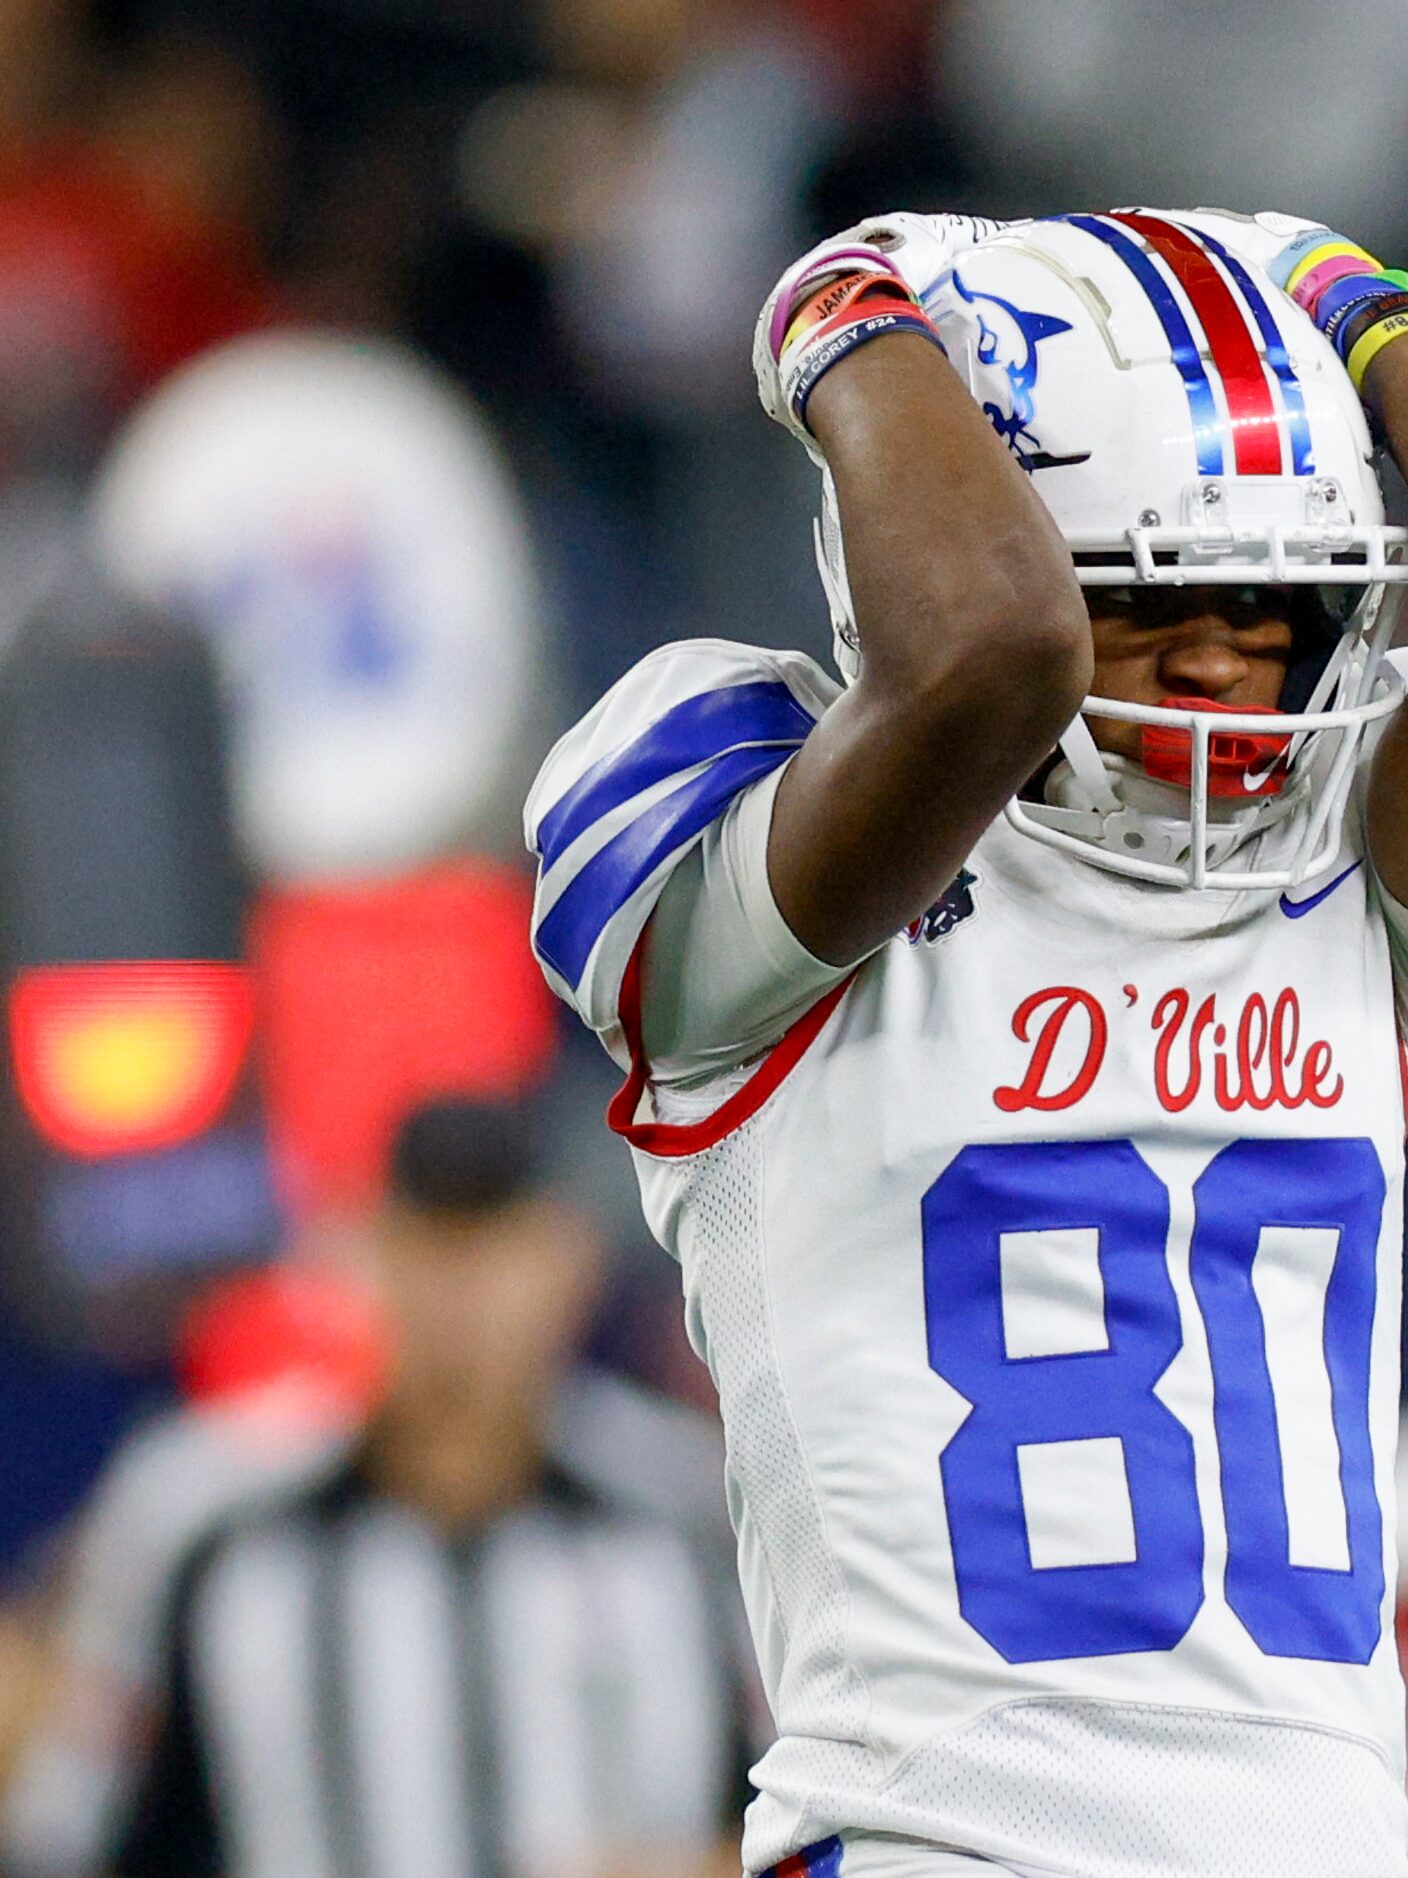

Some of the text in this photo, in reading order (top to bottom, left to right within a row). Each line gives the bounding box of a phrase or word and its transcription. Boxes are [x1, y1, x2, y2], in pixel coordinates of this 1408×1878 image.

[796, 377, 811, 400] LIL
[810, 327, 859, 374] COREY
[866, 316, 896, 331] #24
[992, 984, 1344, 1113] D'Ville
[921, 1137, 1387, 1665] 80
